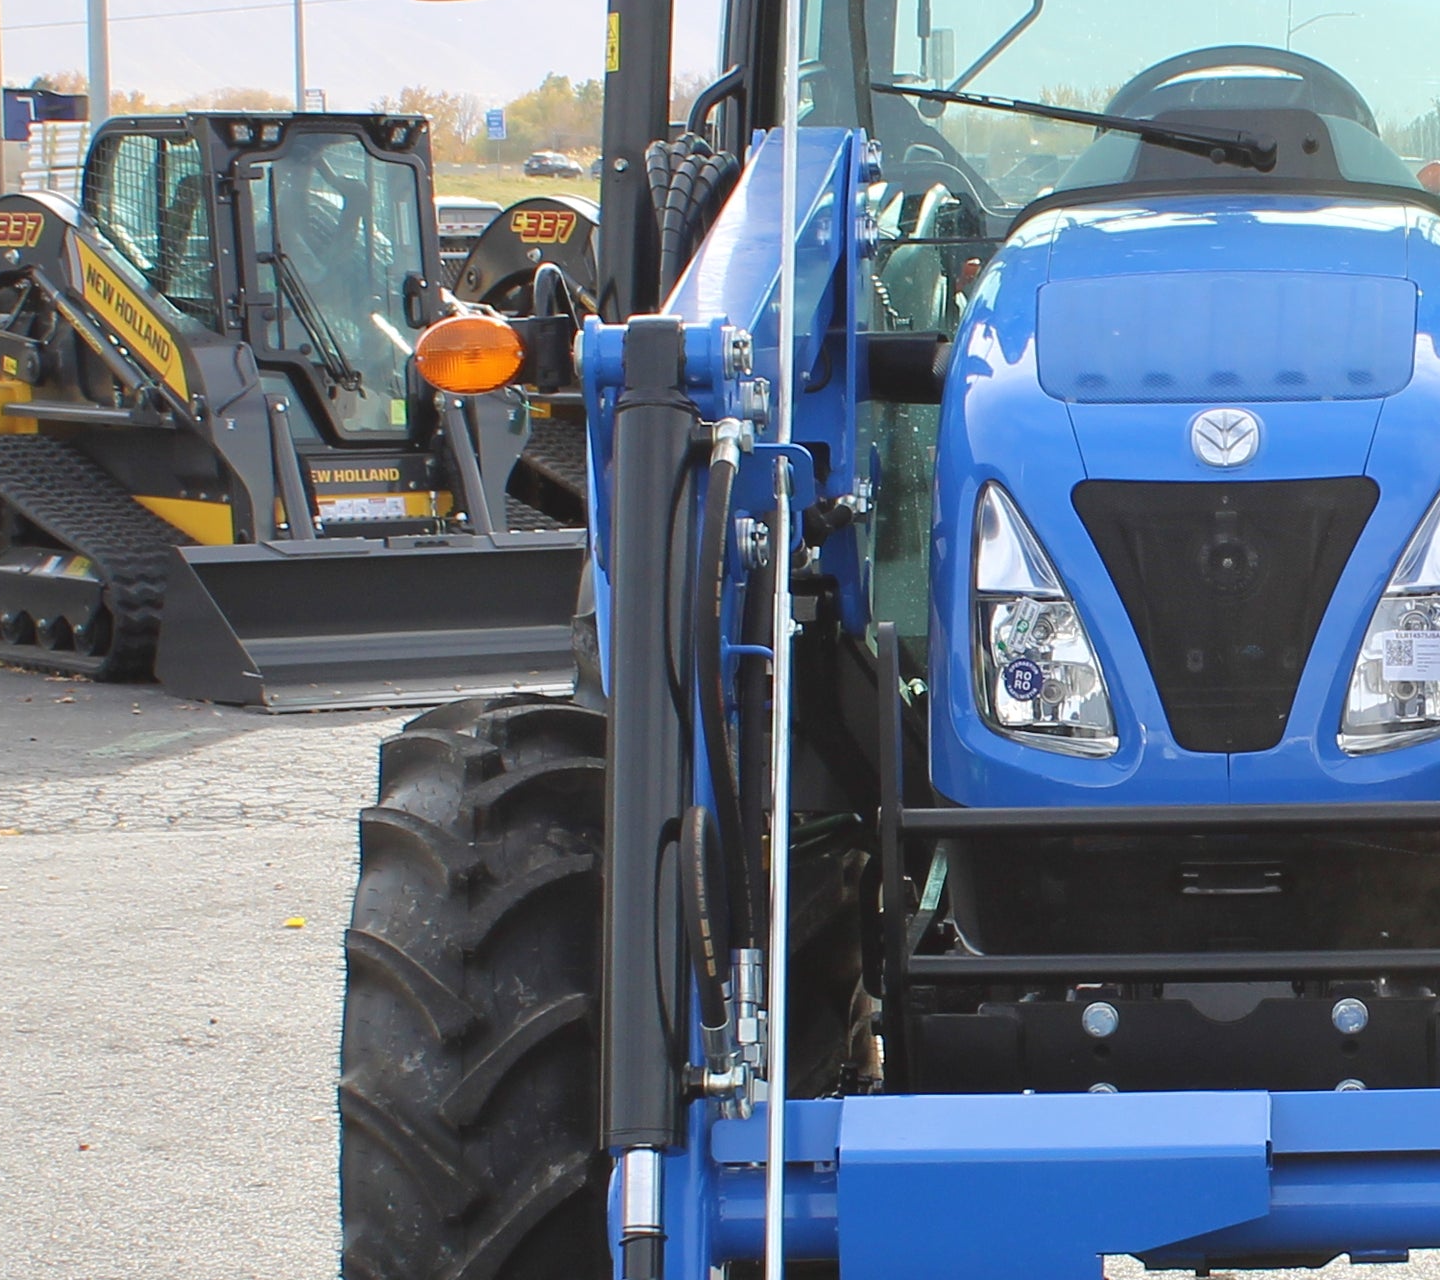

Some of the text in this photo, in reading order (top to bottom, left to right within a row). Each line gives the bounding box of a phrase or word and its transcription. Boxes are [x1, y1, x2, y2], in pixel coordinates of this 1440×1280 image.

[86, 263, 171, 362] NEW HOLLAND
[311, 468, 400, 483] EW HOLLAND
[1015, 670, 1032, 681] RO
[1014, 680, 1031, 691] RO
